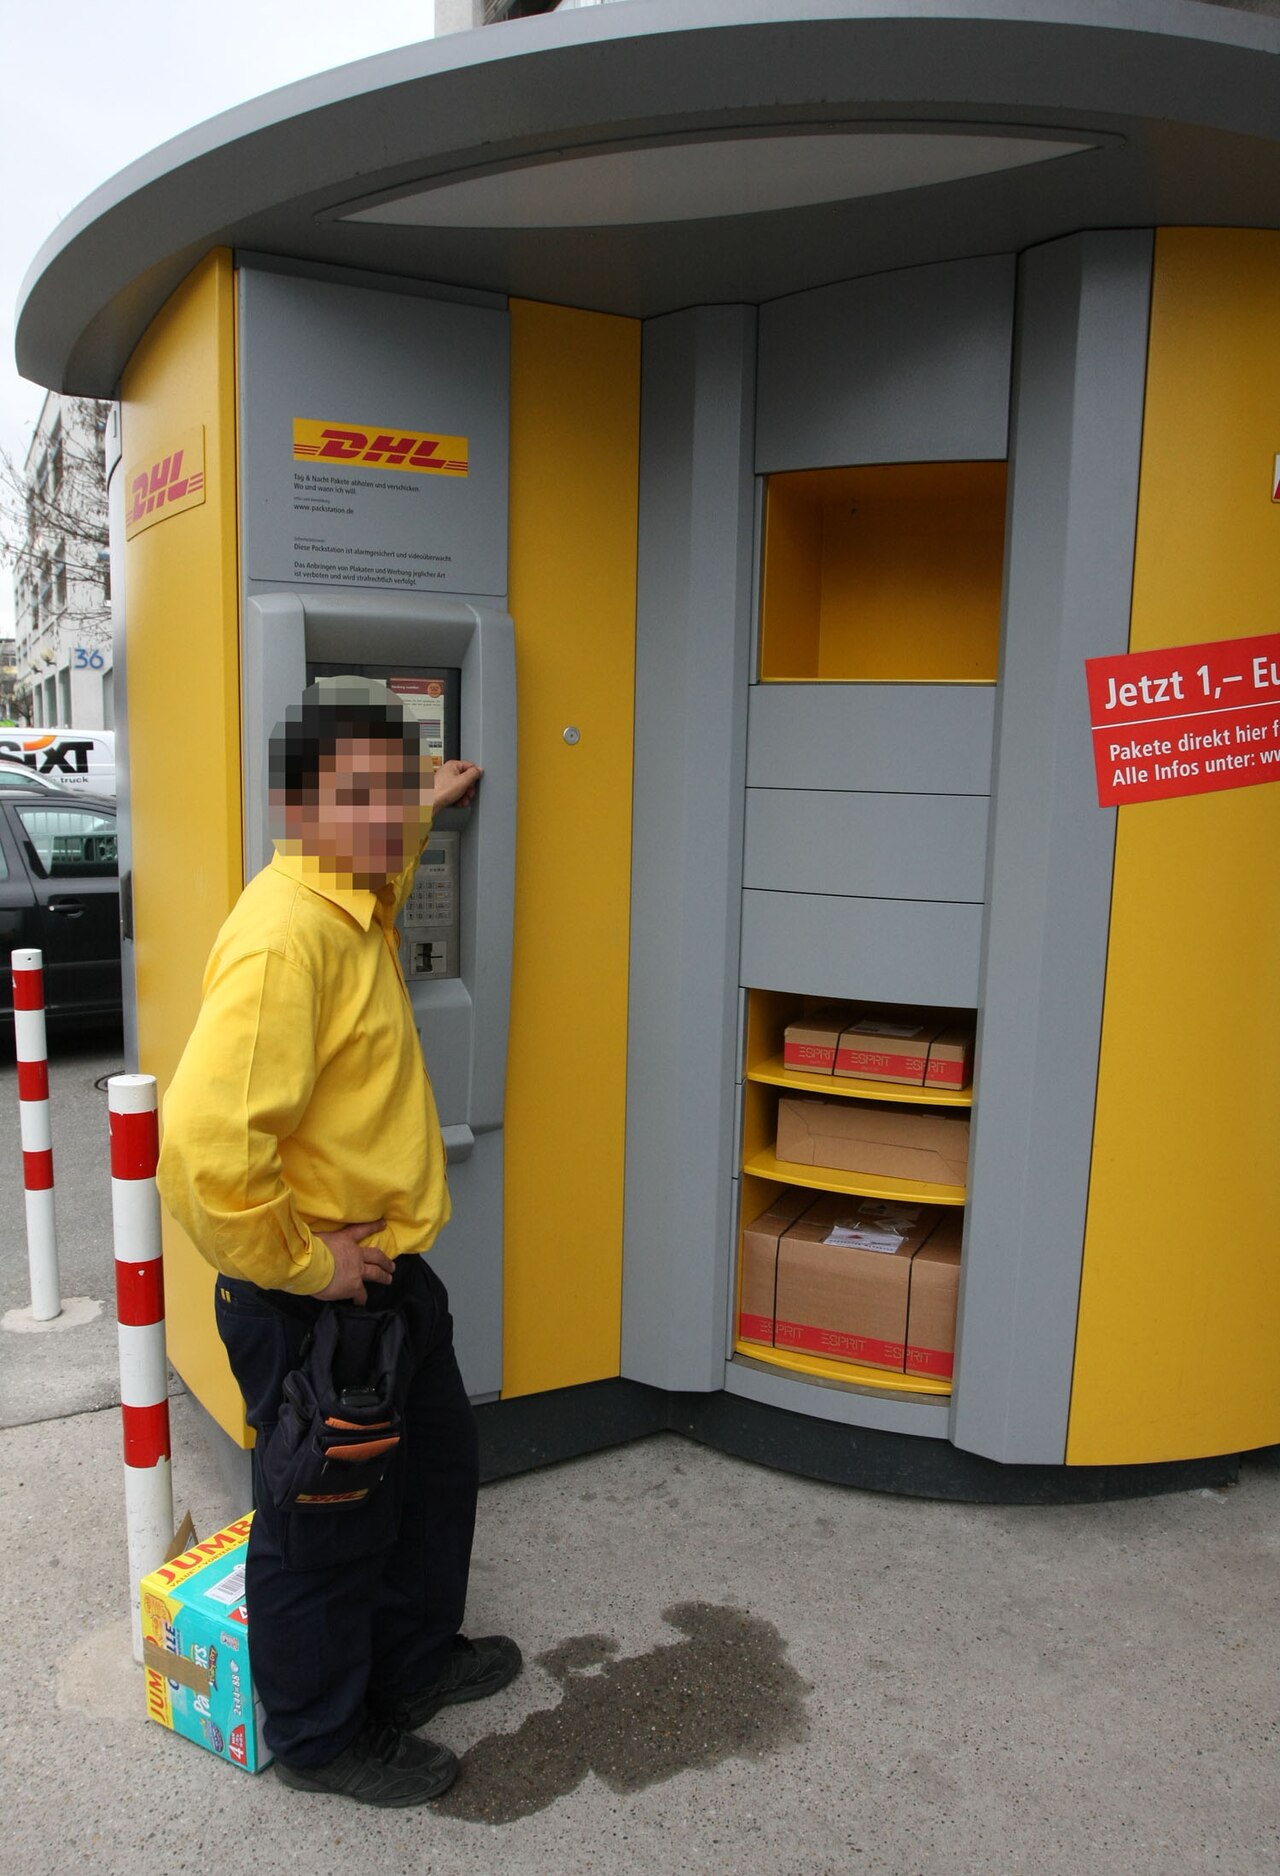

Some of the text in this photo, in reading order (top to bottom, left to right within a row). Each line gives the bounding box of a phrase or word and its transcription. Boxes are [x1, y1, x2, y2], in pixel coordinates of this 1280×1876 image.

[317, 429, 447, 469] DHL
[132, 449, 189, 523] DHL
[294, 473, 305, 482] Tag
[312, 475, 329, 483] Nacht
[330, 477, 350, 486] Pakete
[294, 482, 304, 490] Wo
[335, 486, 344, 494] ich
[293, 504, 354, 514] www.packstation.de
[294, 543, 310, 551] Diese
[311, 544, 345, 554] Packstation
[396, 551, 407, 559] und
[294, 561, 306, 569] Das
[306, 562, 337, 571] Anbringen
[349, 565, 375, 573] Plakaten
[387, 568, 412, 577] Werbung
[303, 571, 329, 579] verboten
[74, 648, 105, 670] 36
[1105, 671, 1185, 710] Jetzt
[1109, 740, 1172, 761] Pakete
[1178, 729, 1231, 752] direkt
[1235, 724, 1268, 744] hier
[1112, 766, 1149, 787] Alle
[1154, 760, 1200, 781] Infos
[1205, 753, 1256, 774] unter:
[850, 1052, 892, 1067] ESPRIT
[820, 1333, 868, 1351] ESPRIT
[228, 1744, 244, 1760] 4
